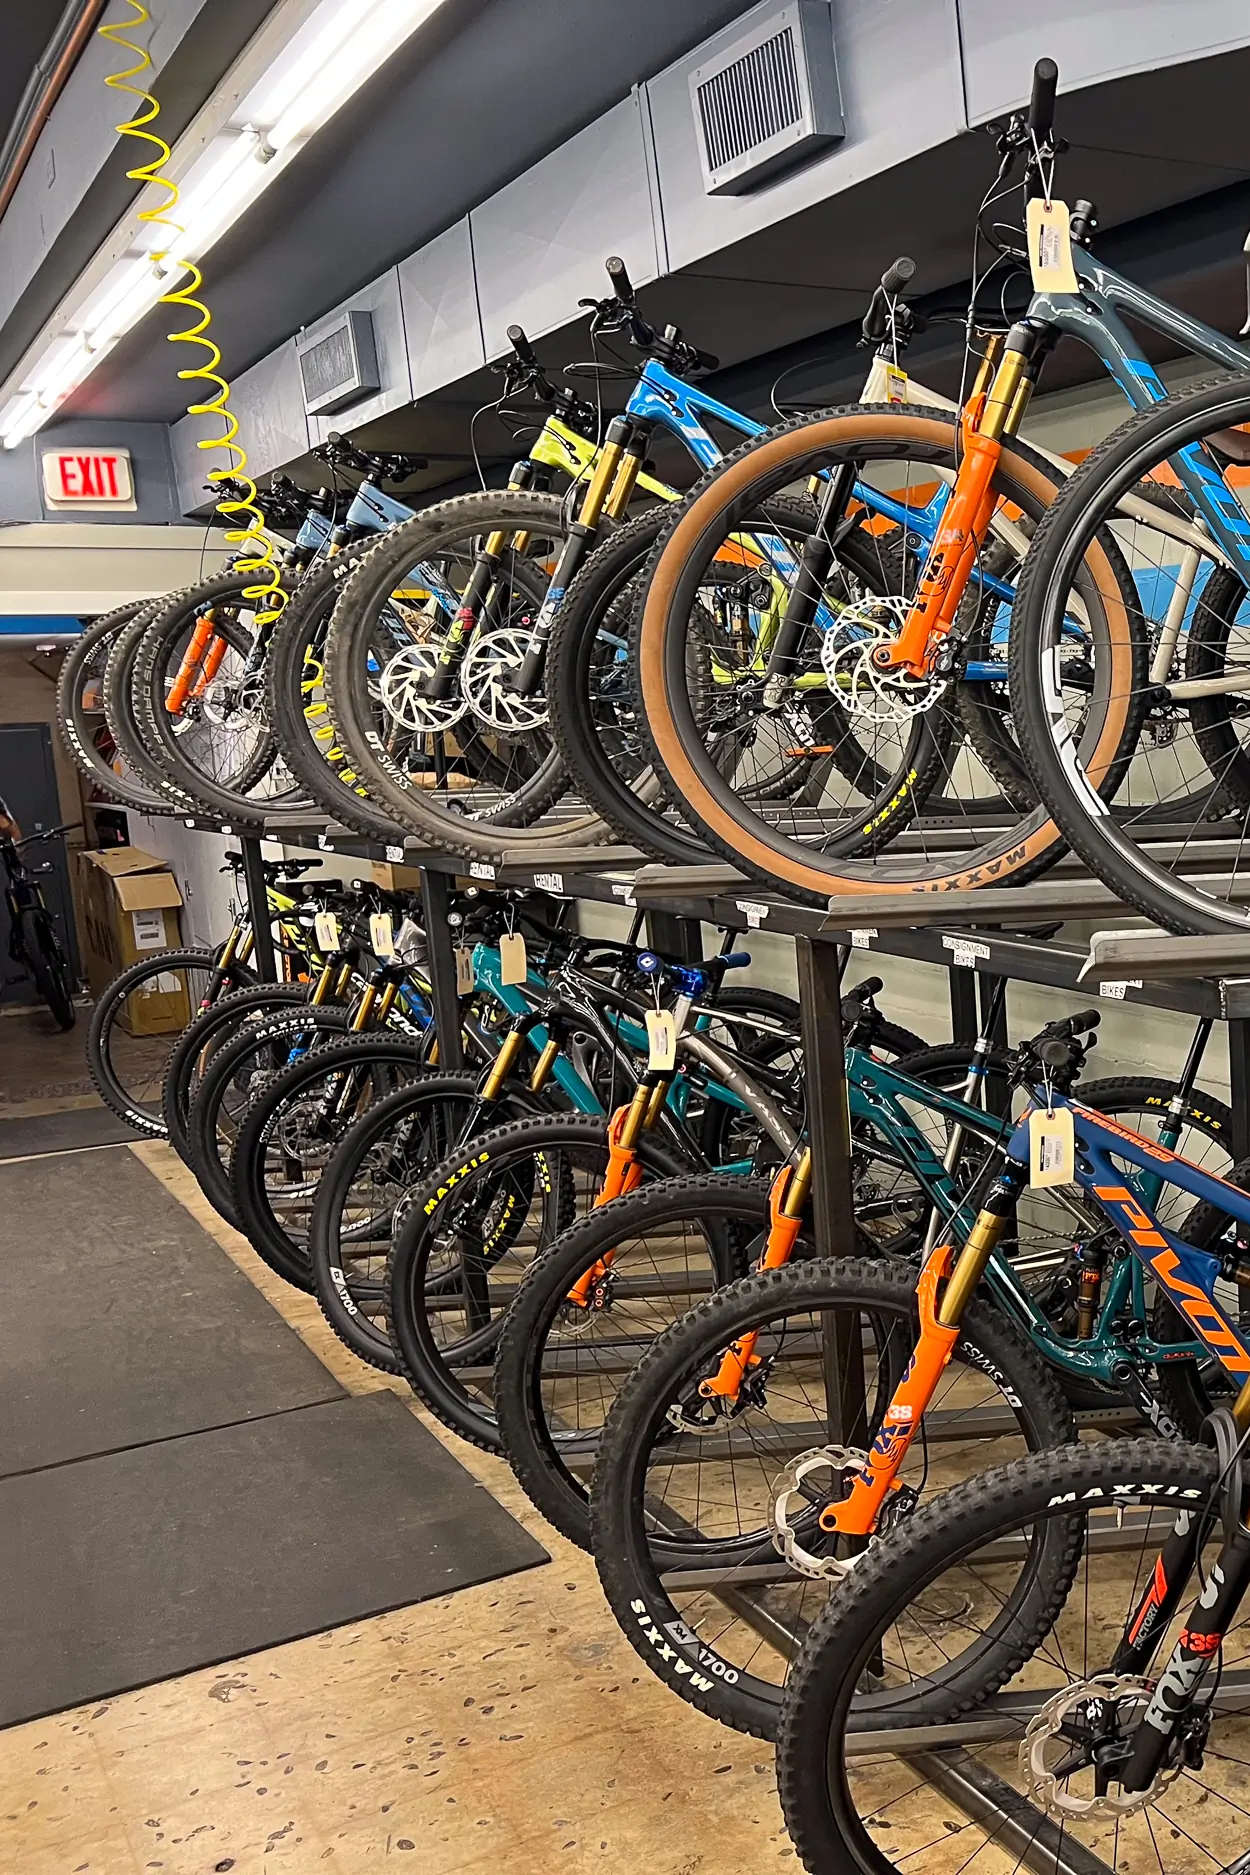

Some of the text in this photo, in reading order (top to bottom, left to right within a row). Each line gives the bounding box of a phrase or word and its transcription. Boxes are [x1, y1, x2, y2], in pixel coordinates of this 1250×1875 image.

[58, 456, 119, 498] EXIT
[143, 635, 164, 682] HANS
[364, 731, 413, 791] DT SWISS
[862, 768, 918, 836] MAXXIS
[535, 875, 563, 892] RENTAL
[942, 936, 989, 957] CONSIGNMENT
[955, 954, 975, 968] BIKES
[1101, 984, 1125, 998] BIKES
[255, 1017, 316, 1040] MAXXIS
[258, 1112, 280, 1144] SWISS
[423, 1152, 491, 1216] MAXXIS
[339, 1288, 358, 1316] 1700
[960, 1341, 1022, 1409] DT SWISS
[1047, 1483, 1203, 1508] MAXXIS
[630, 1598, 715, 1692] MAXXIS
[1132, 1603, 1159, 1651] FACTORY
[698, 1648, 739, 1685] 1700
[1143, 1643, 1211, 1735] FOX
